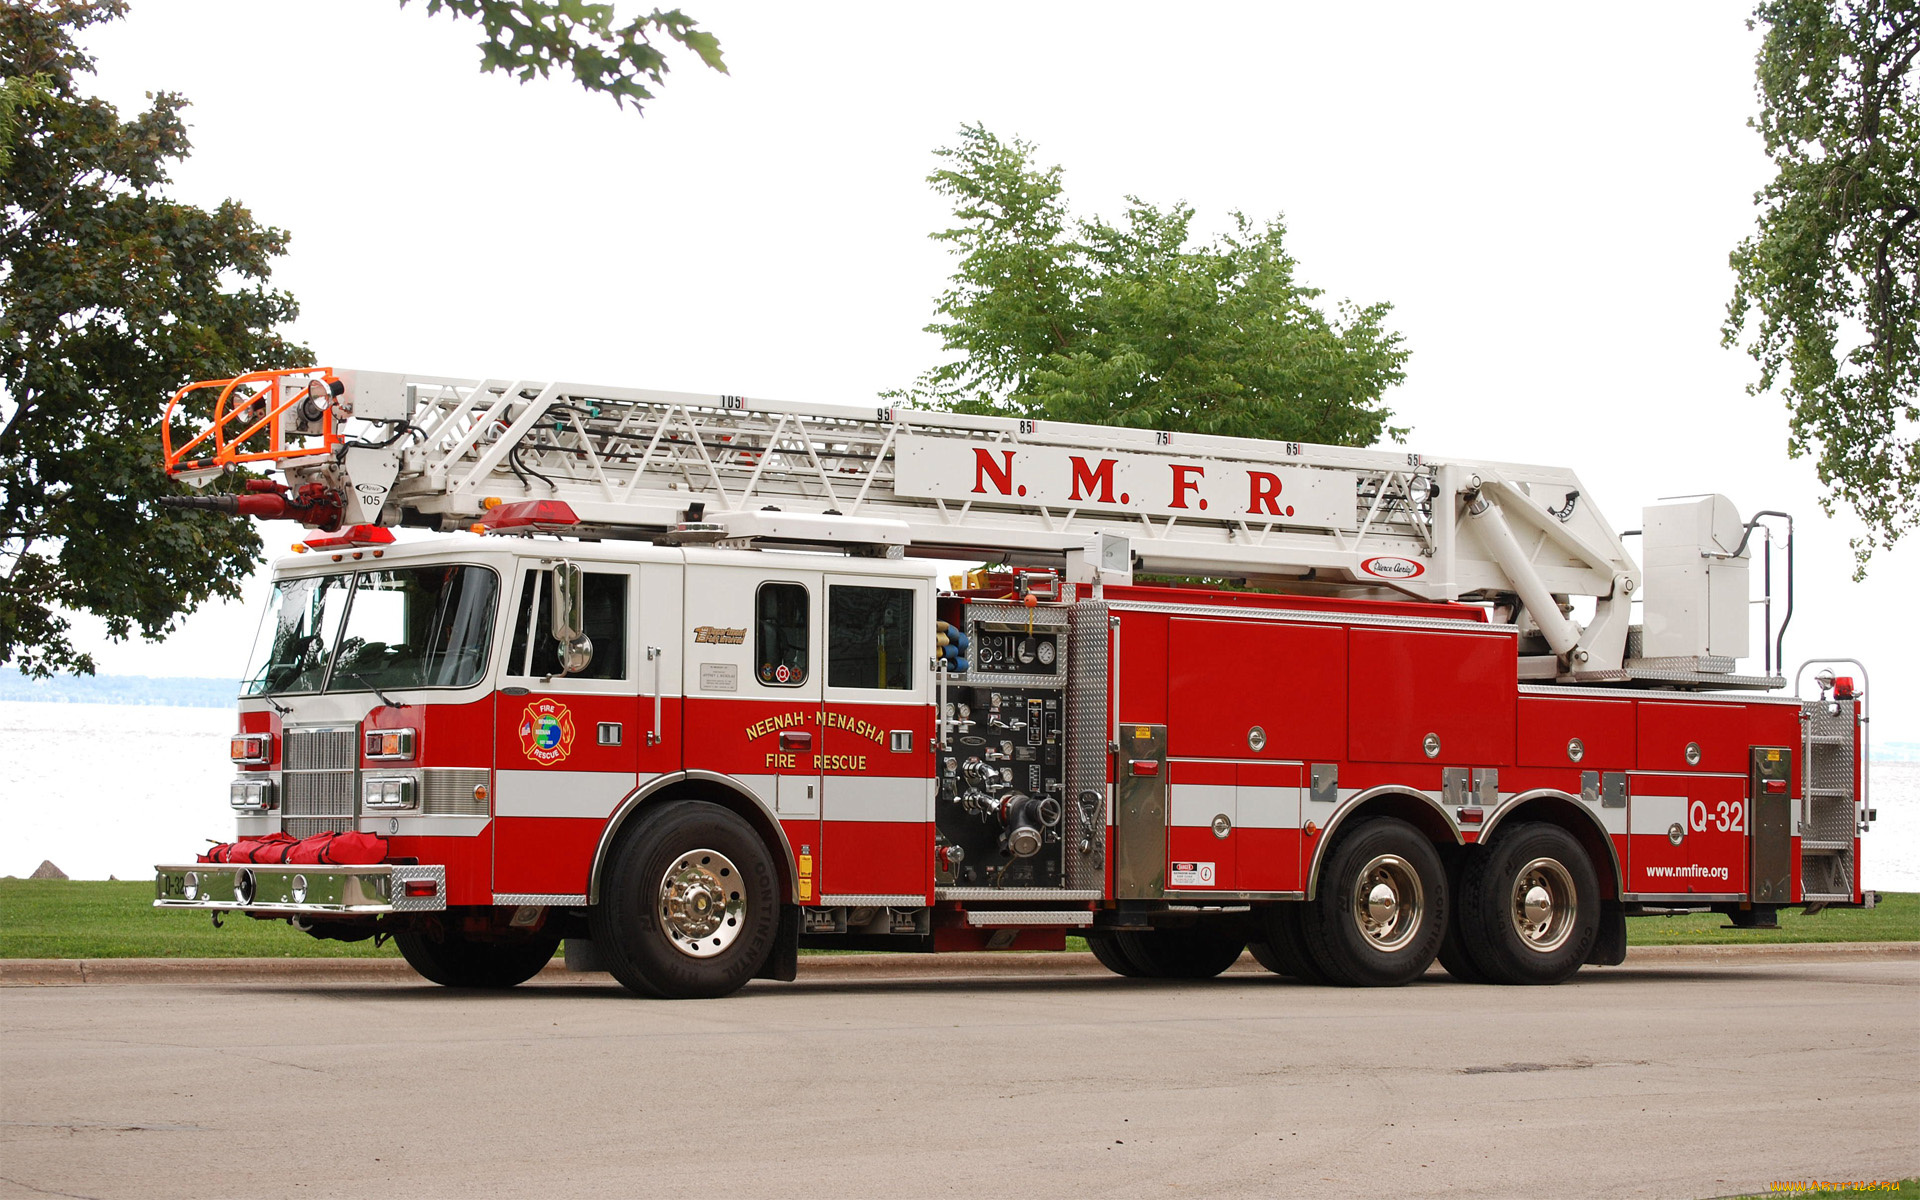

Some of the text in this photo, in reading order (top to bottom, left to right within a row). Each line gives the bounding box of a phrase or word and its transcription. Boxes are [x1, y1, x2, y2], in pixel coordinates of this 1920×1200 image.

[721, 395, 741, 409] 105
[877, 408, 890, 421] 95
[1020, 420, 1032, 434] 85
[1156, 432, 1168, 445] 75
[1286, 443, 1298, 456] 65
[1407, 454, 1418, 466] 55
[970, 447, 1295, 517] N. M. F. R.
[362, 495, 380, 506] 105
[1373, 559, 1393, 572] Pierce
[540, 704, 555, 713] FIRE
[745, 711, 804, 741] NEENAH
[533, 748, 560, 760] RESCUE
[765, 753, 867, 770] FIRE RESCUE
[1689, 800, 1743, 832] Q-32
[1646, 864, 1729, 880] www.nmfire.org
